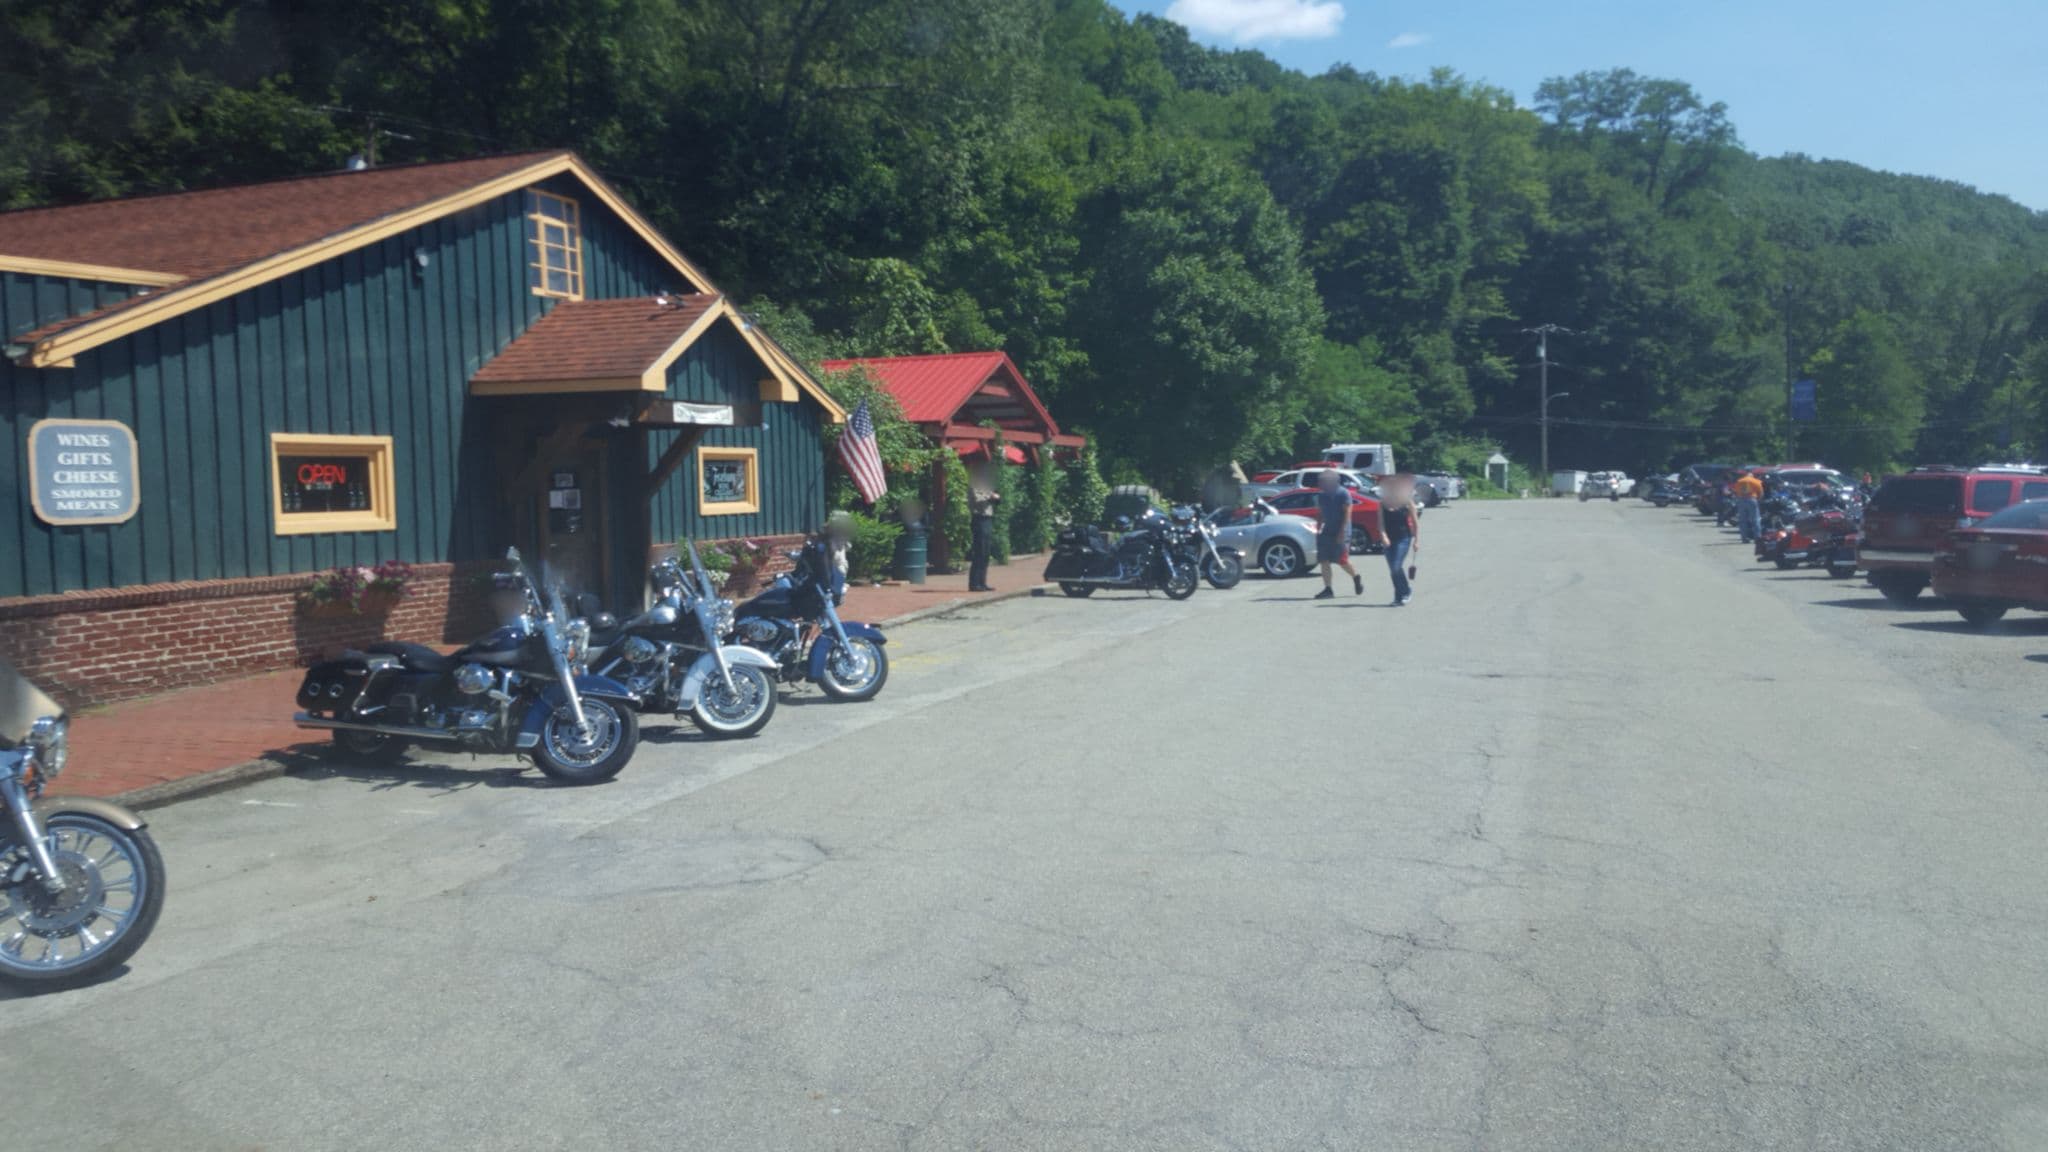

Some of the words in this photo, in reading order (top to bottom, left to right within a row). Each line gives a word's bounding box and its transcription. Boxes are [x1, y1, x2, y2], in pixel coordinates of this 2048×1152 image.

[57, 433, 110, 447] WINES
[57, 452, 112, 465] GIFTS
[53, 471, 119, 484] CHEESE
[298, 463, 346, 484] OPEN
[51, 488, 122, 499] SMOKED
[56, 500, 120, 511] MEATS
